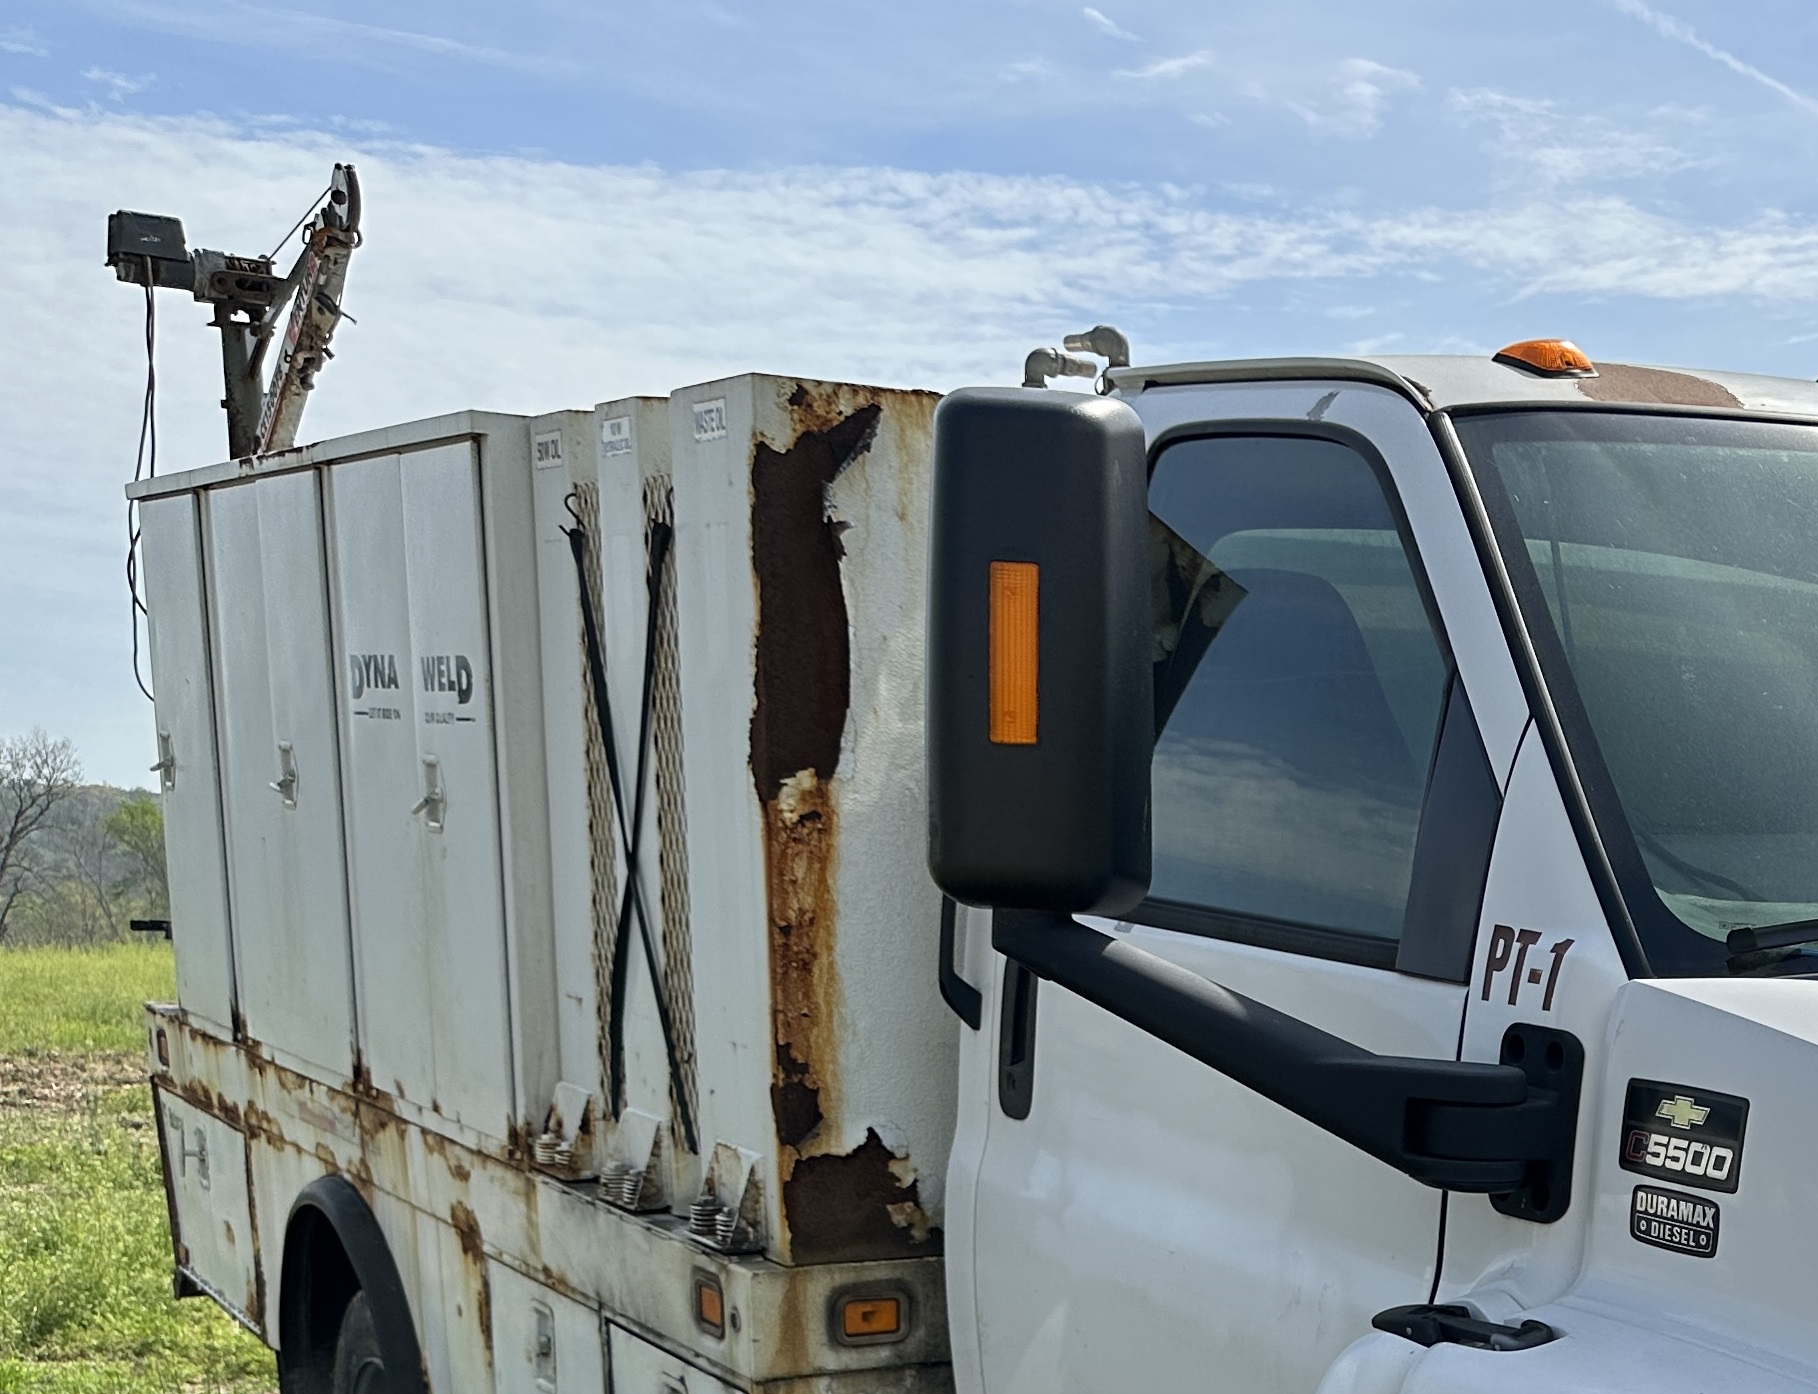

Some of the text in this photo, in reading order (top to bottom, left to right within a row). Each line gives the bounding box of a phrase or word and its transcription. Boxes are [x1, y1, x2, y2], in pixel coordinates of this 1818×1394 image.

[350, 654, 473, 704] DYNA WELD
[1481, 924, 1575, 1011] PT-1
[1626, 1129, 1733, 1180] C5500
[1636, 1191, 1716, 1228] DURAMAX
[1650, 1221, 1696, 1246] DIESEL
